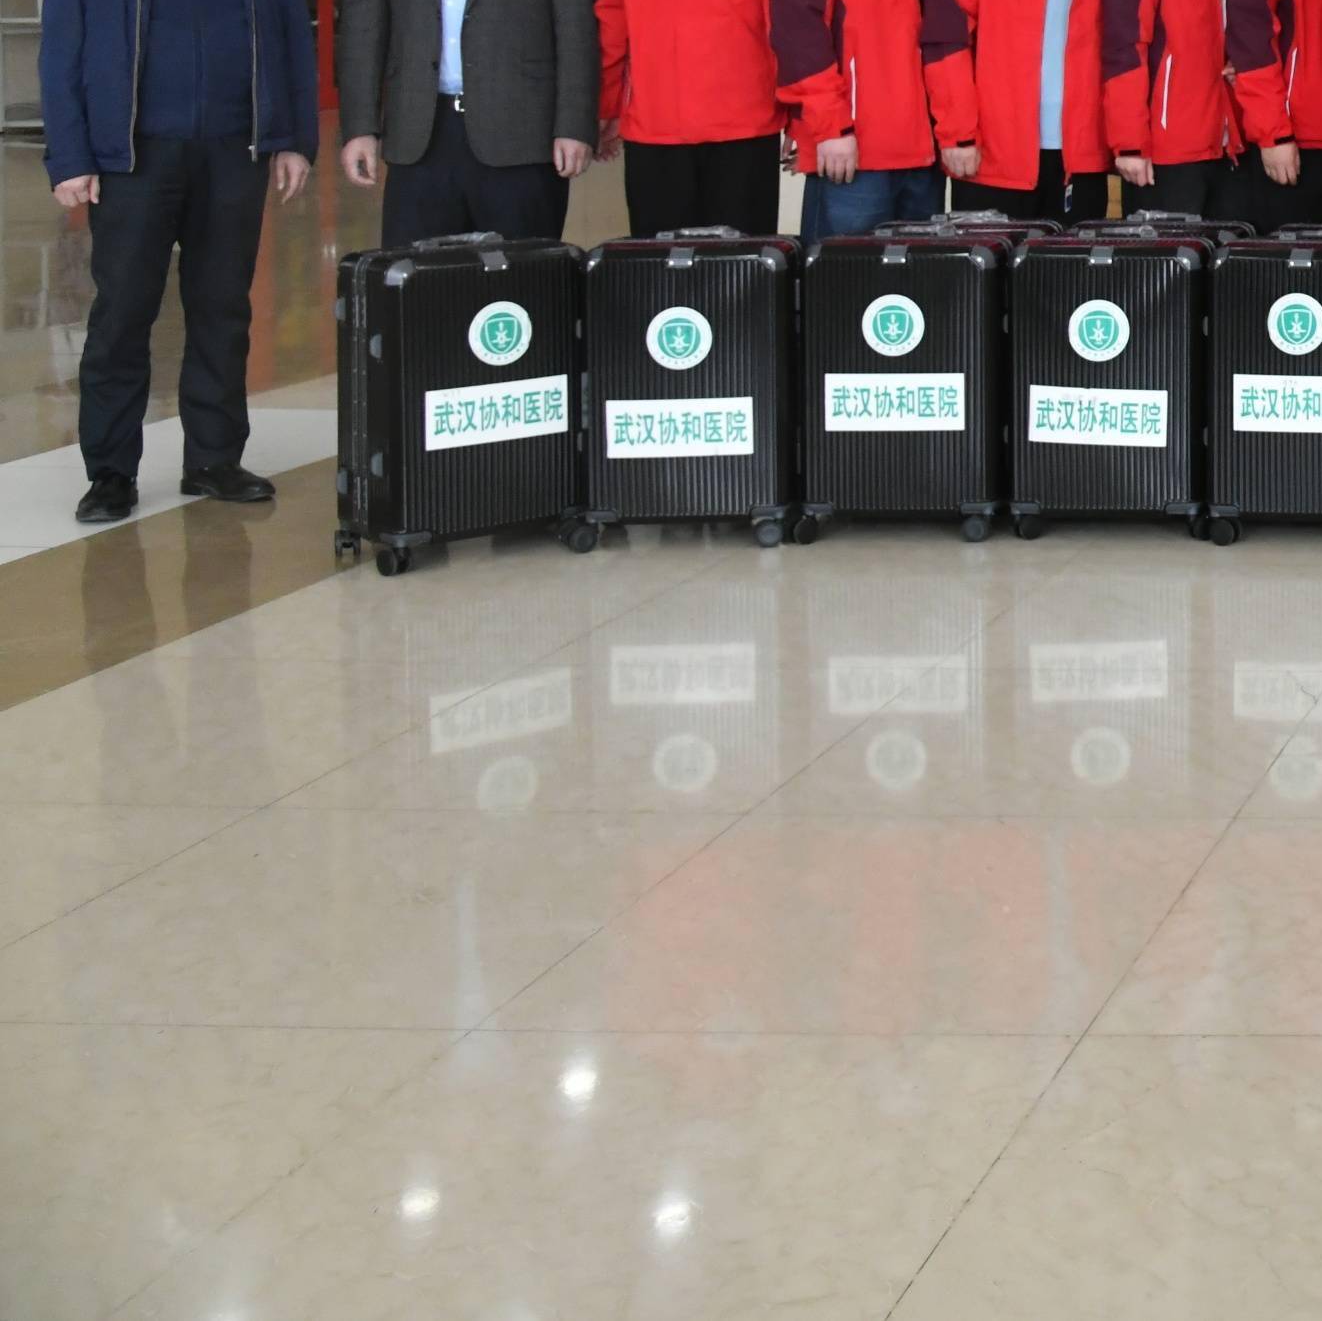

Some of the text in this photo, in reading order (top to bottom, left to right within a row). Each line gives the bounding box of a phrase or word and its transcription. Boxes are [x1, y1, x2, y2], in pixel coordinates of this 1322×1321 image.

[433, 387, 564, 436] 武汉协和医院
[832, 385, 960, 419] 武汉协和医院
[1034, 400, 1162, 435] 武汉协和医院
[613, 411, 746, 444] 武汉协和医院
